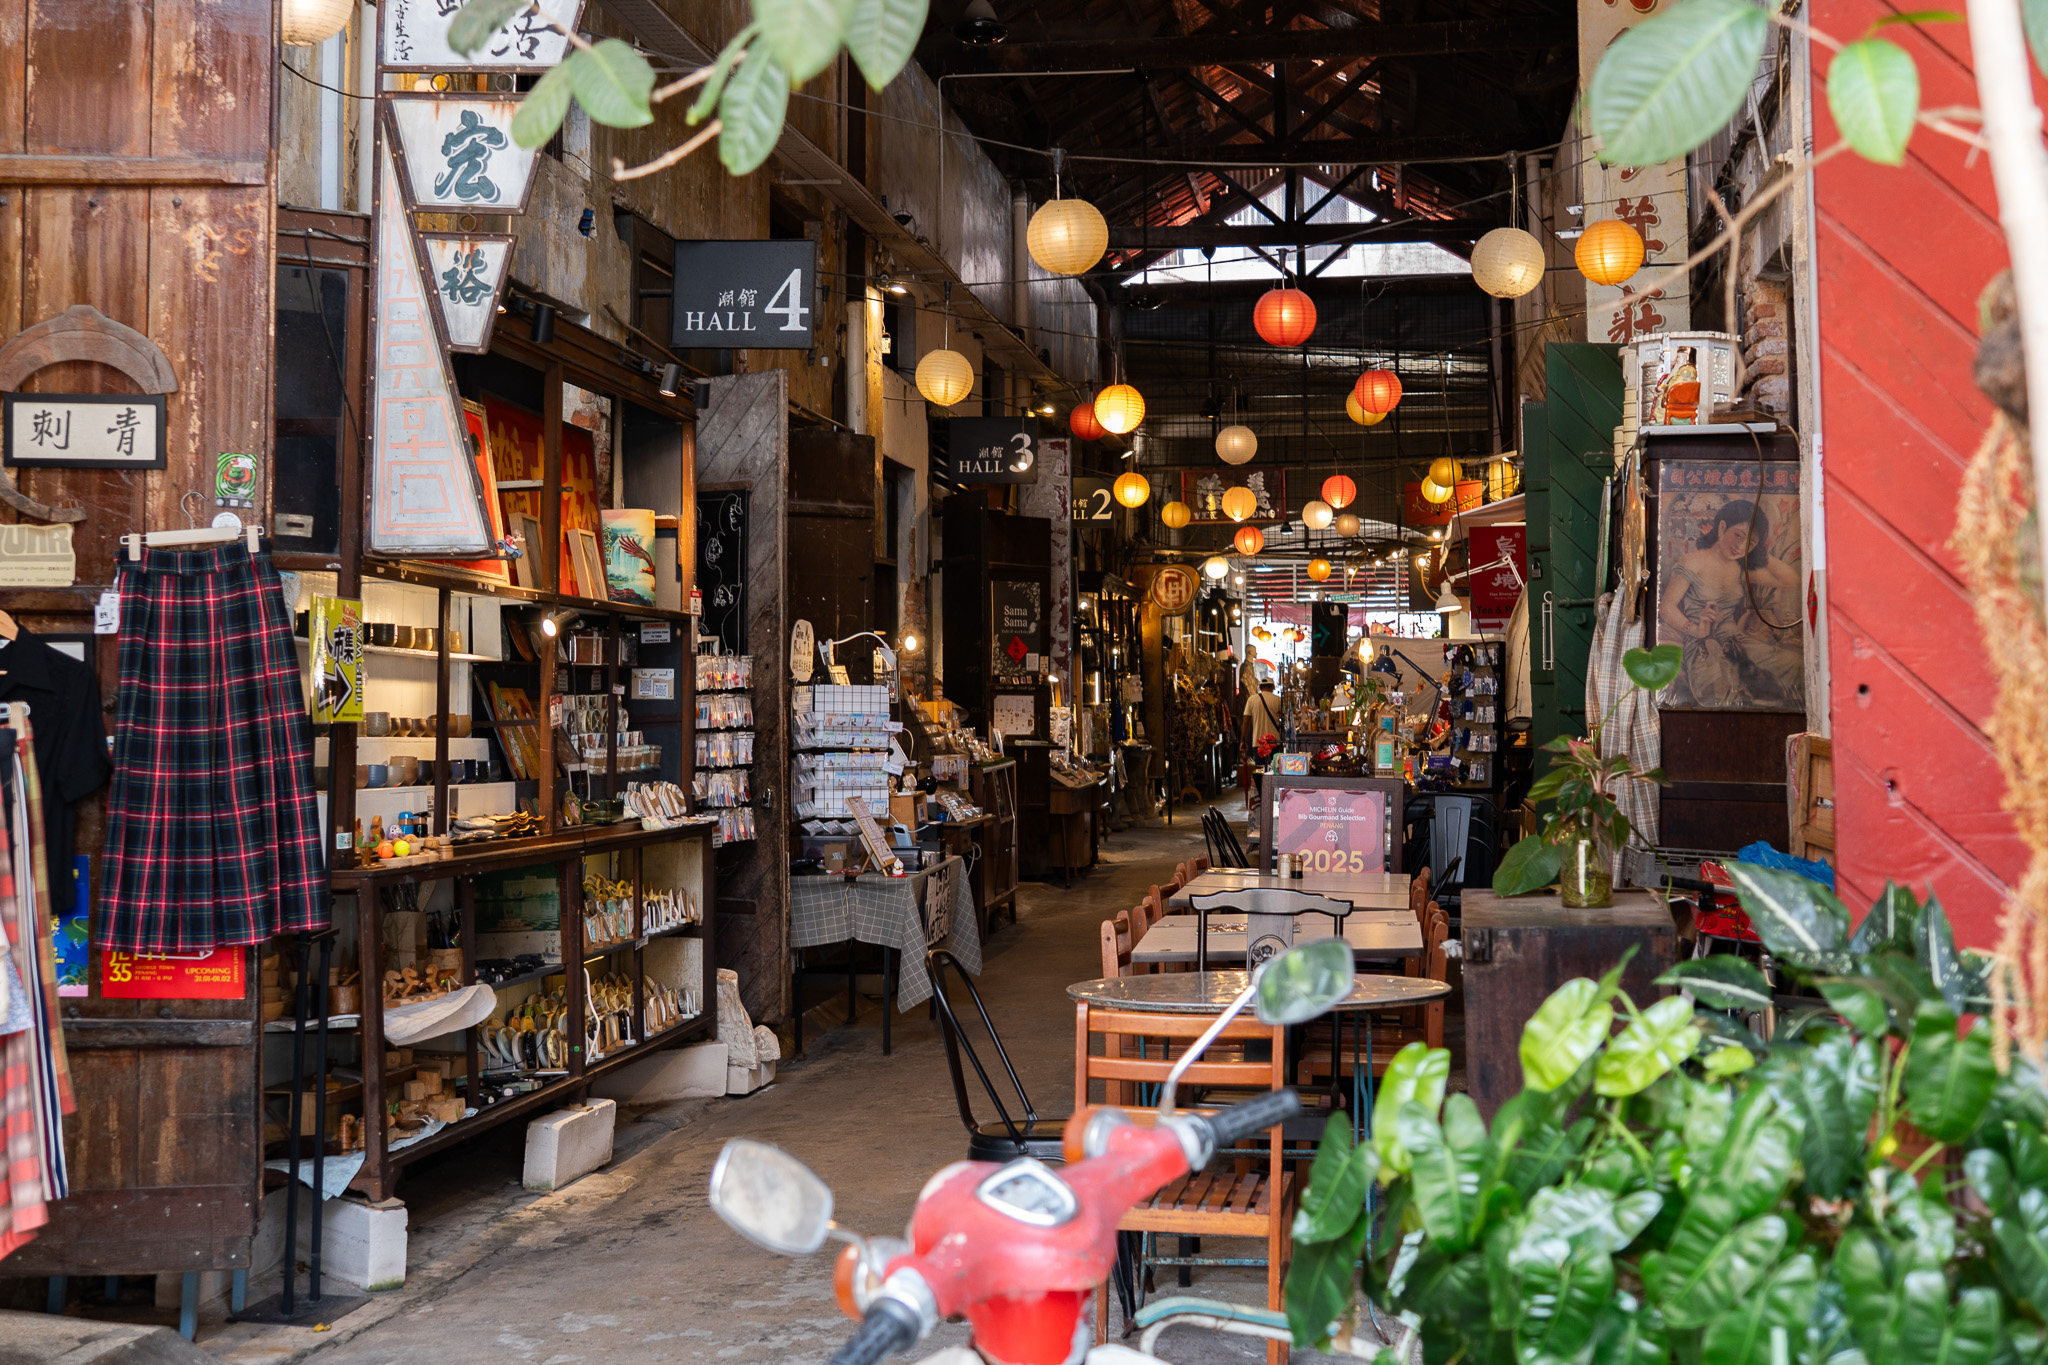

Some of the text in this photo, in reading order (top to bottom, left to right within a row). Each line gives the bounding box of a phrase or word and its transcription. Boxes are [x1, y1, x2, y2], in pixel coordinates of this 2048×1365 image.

[434, 109, 509, 204] 宏
[685, 268, 810, 331] HALL 4
[718, 288, 758, 308] 潮館
[30, 407, 142, 457] 刺青
[958, 433, 1034, 474] HALL 3
[1072, 488, 1113, 520] LL 2
[1004, 604, 1028, 616] Sama
[1477, 605, 1493, 615] Tea
[1004, 616, 1028, 628] Sama
[1298, 849, 1364, 873] 2025
[109, 963, 132, 982] 35
[185, 967, 231, 975] UPCOMING
